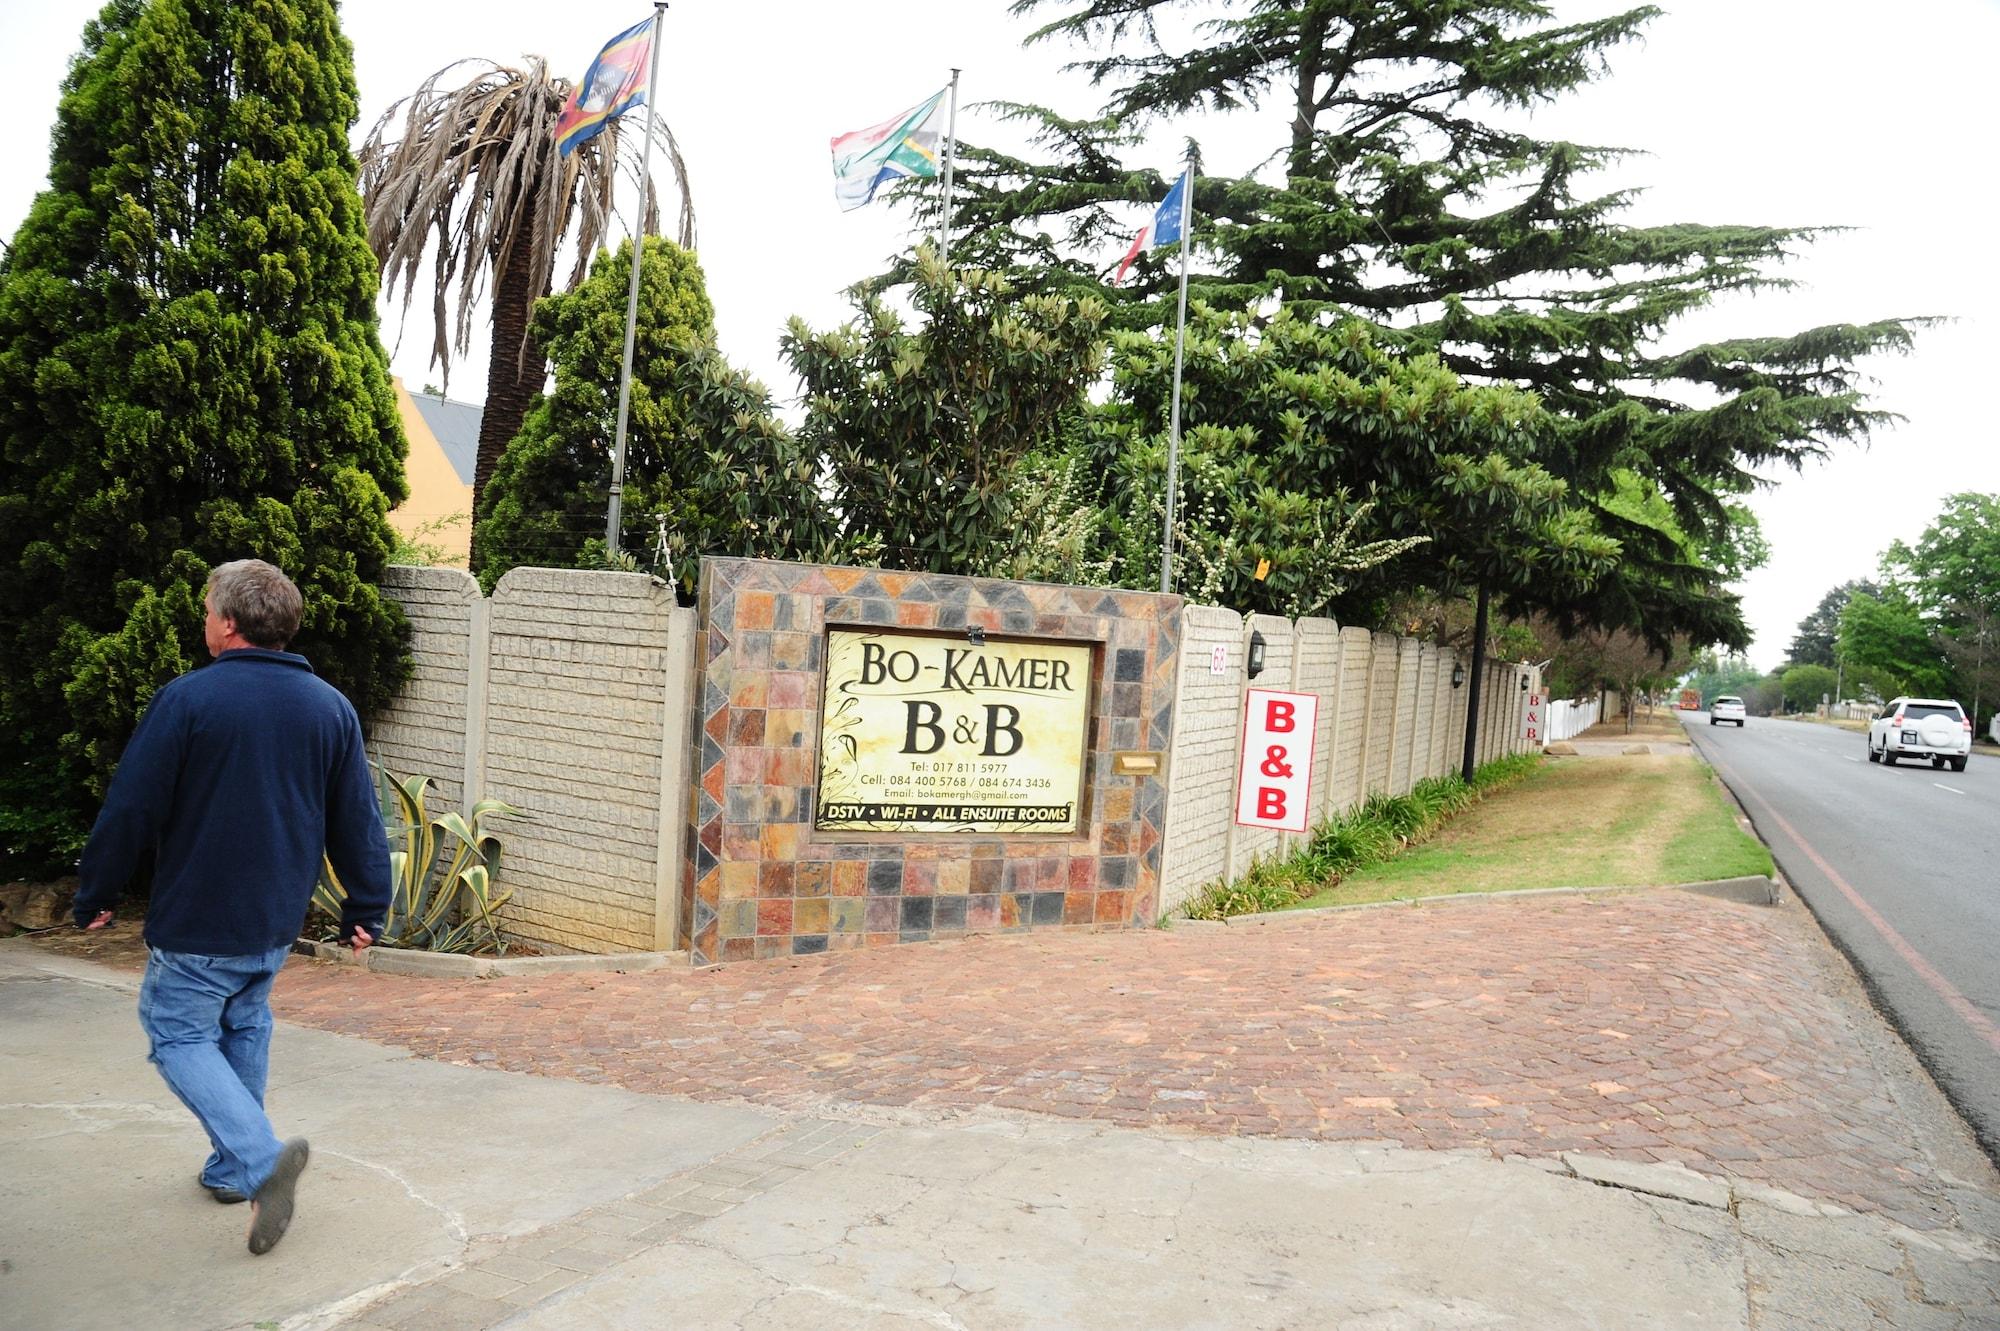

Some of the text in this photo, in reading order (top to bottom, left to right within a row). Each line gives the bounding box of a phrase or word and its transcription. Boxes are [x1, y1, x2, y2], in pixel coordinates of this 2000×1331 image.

[859, 643, 1075, 694] BO-KAMER
[911, 762, 1007, 774] Tel: 017 811 5977
[861, 775, 886, 785] Cell:
[890, 776, 911, 785] 084
[915, 776, 936, 786] 400
[939, 777, 967, 787] 5768
[978, 777, 998, 787] 084
[1002, 778, 1022, 788] 674
[1025, 778, 1051, 788] 3436
[884, 788, 1028, 801] Email: bokamergh@gmail.com
[827, 805, 1067, 821] DSTV WI-FI ALL ENSUITE ROOMS
